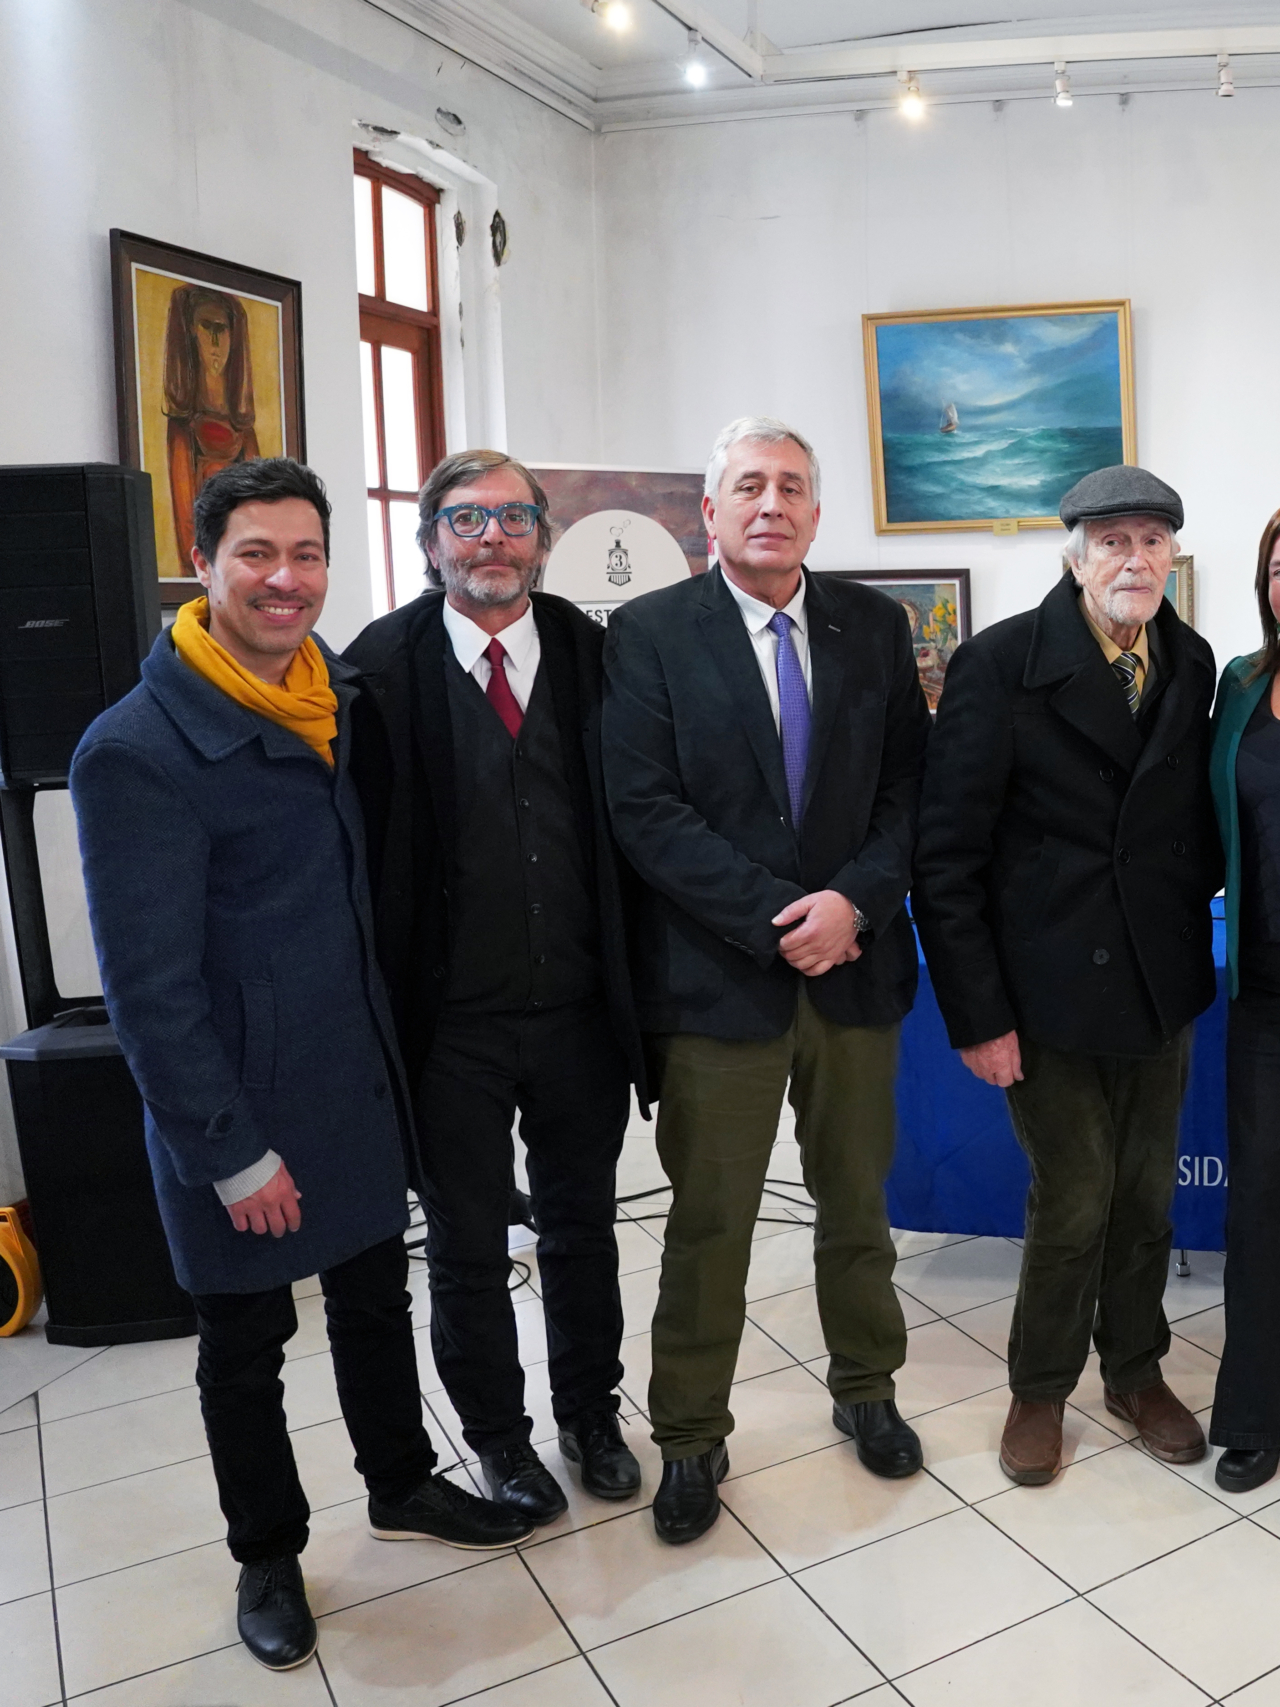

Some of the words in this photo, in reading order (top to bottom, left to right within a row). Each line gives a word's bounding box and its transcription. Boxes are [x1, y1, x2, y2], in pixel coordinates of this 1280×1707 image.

[614, 554, 623, 568] 3
[18, 618, 69, 629] BOSE
[1178, 1155, 1228, 1187] SID
